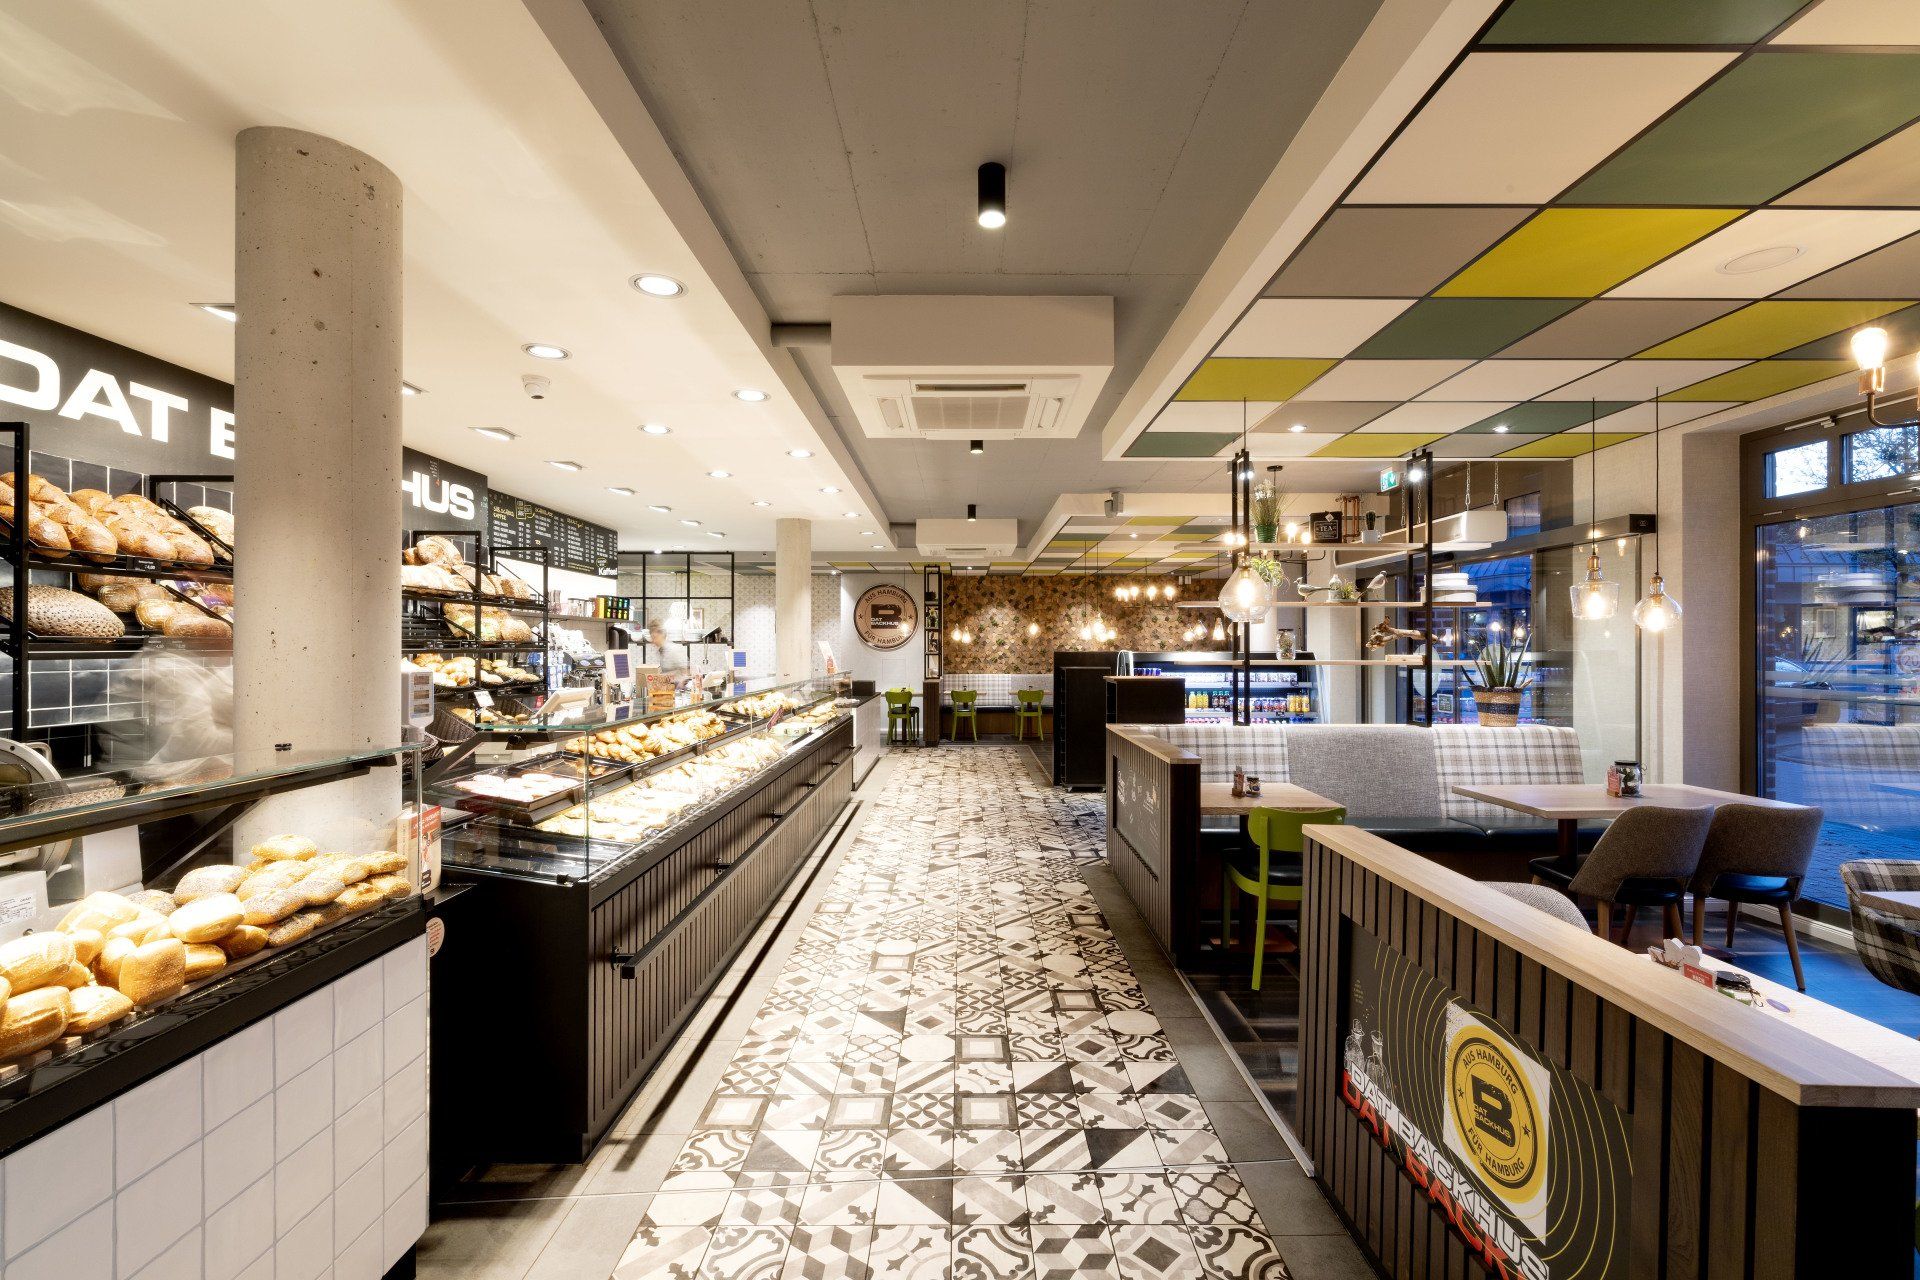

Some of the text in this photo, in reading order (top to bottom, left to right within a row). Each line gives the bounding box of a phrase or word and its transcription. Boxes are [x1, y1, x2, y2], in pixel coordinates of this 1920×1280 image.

[0, 339, 189, 443] DAT
[864, 589, 908, 604] AUS HAMBURG
[877, 635, 904, 645] HAMBU
[1462, 1048, 1518, 1095] AUS HAMBURG
[1351, 1061, 1548, 1280] DAT BACKHUS
[1468, 1126, 1525, 1177] FÜR HAMBURG
